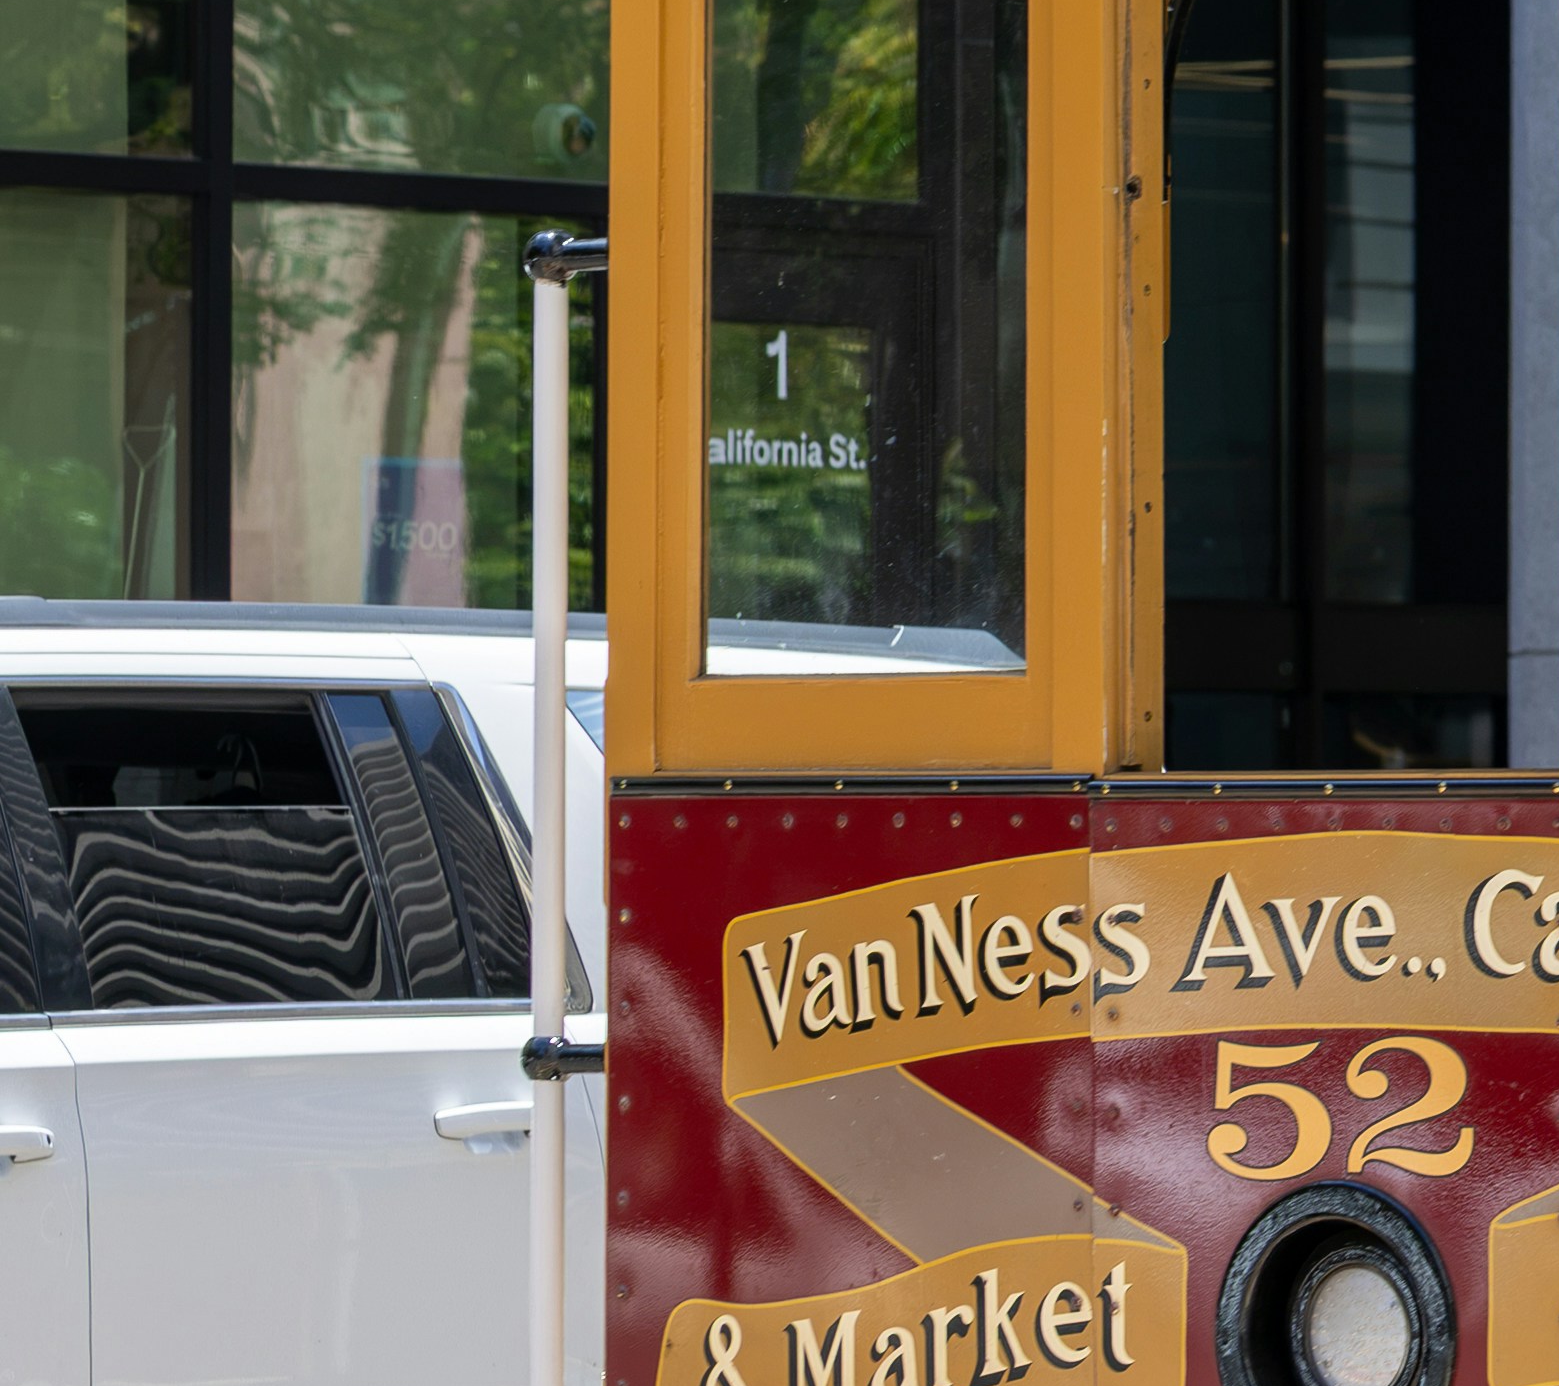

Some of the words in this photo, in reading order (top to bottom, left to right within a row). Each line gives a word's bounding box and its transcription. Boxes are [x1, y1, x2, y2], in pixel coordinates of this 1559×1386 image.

[766, 329, 788, 401] 1
[708, 428, 824, 469] alifornia
[829, 433, 867, 470] St.
[746, 924, 904, 1046] Van
[916, 893, 1150, 1018] Ness
[1206, 1036, 1475, 1181] 52
